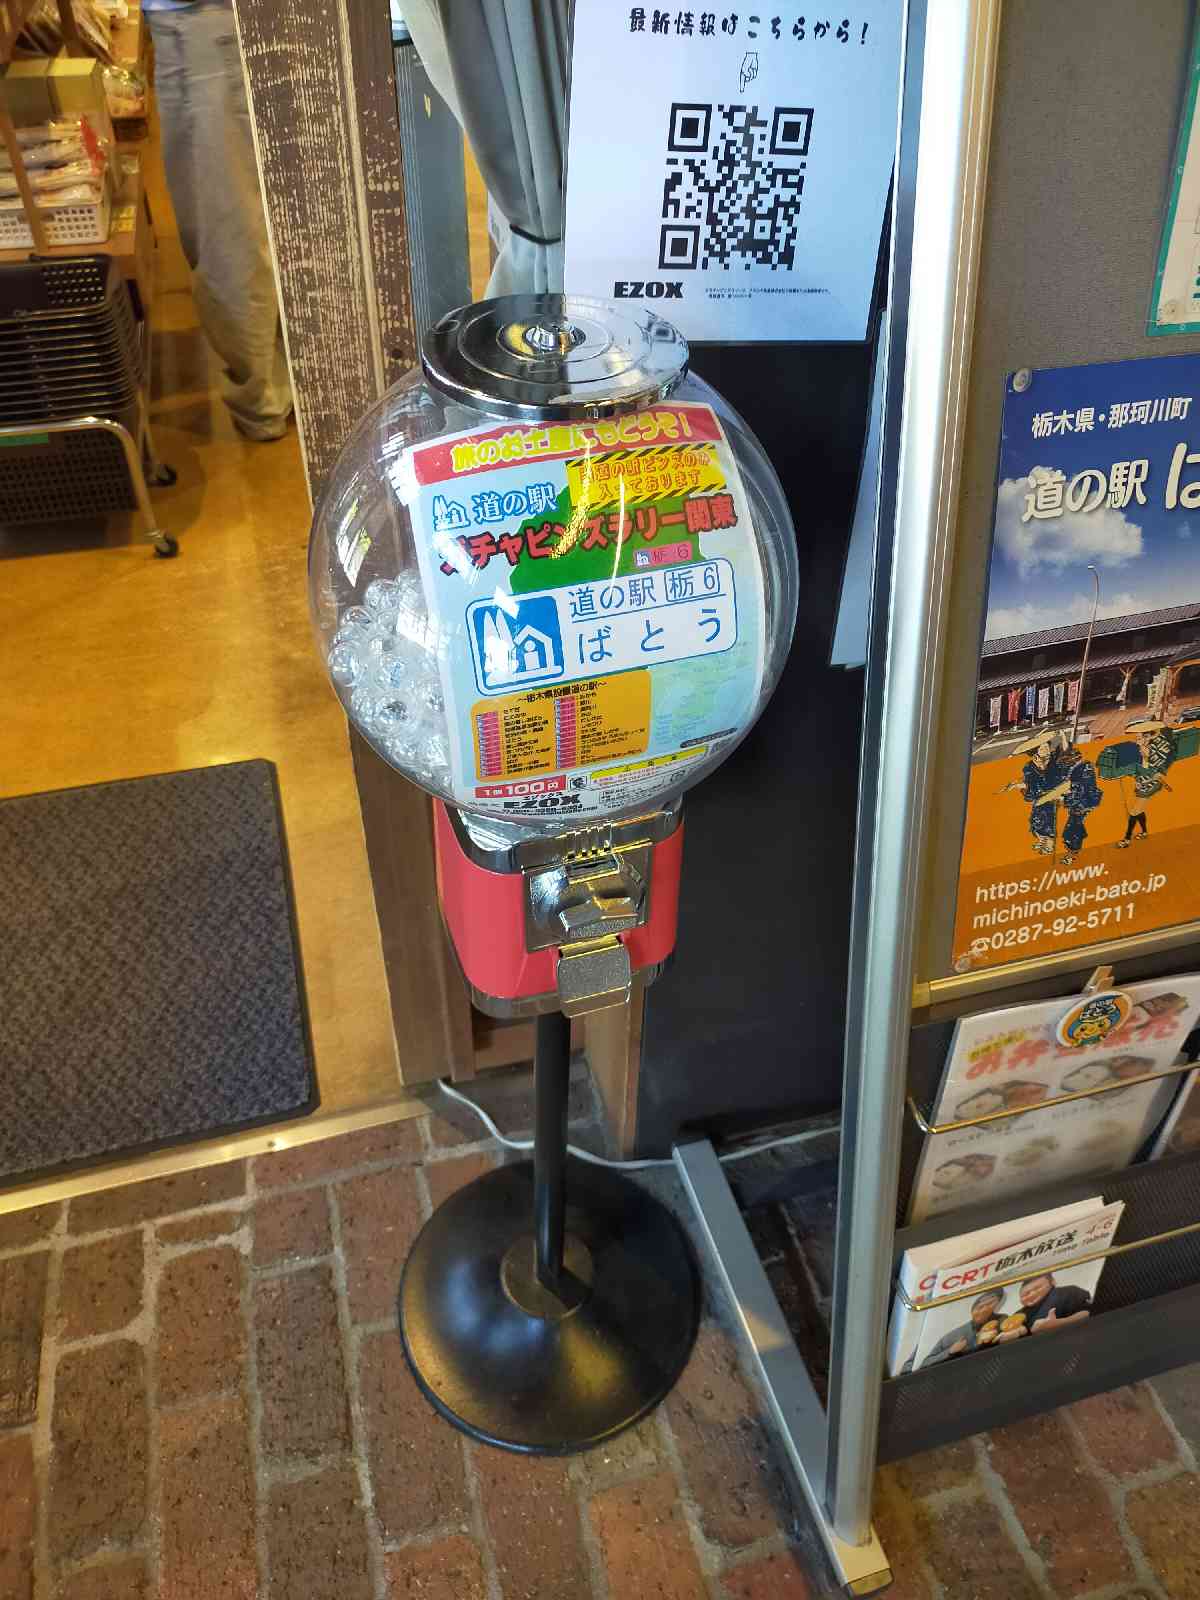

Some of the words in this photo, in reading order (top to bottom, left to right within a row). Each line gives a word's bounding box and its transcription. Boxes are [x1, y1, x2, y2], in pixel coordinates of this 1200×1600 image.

[629, 8, 869, 45] 最新情報はこちらから！
[613, 281, 685, 299] EZOX
[475, 483, 558, 524] 道の駅
[1021, 459, 1148, 523] 道の駅
[569, 577, 656, 618] 道の駅
[504, 794, 581, 808] EZOX
[973, 872, 1167, 930] michinoeki-bato.jp
[974, 863, 1109, 904] https://www.
[990, 902, 1137, 951] 0287-92-5711
